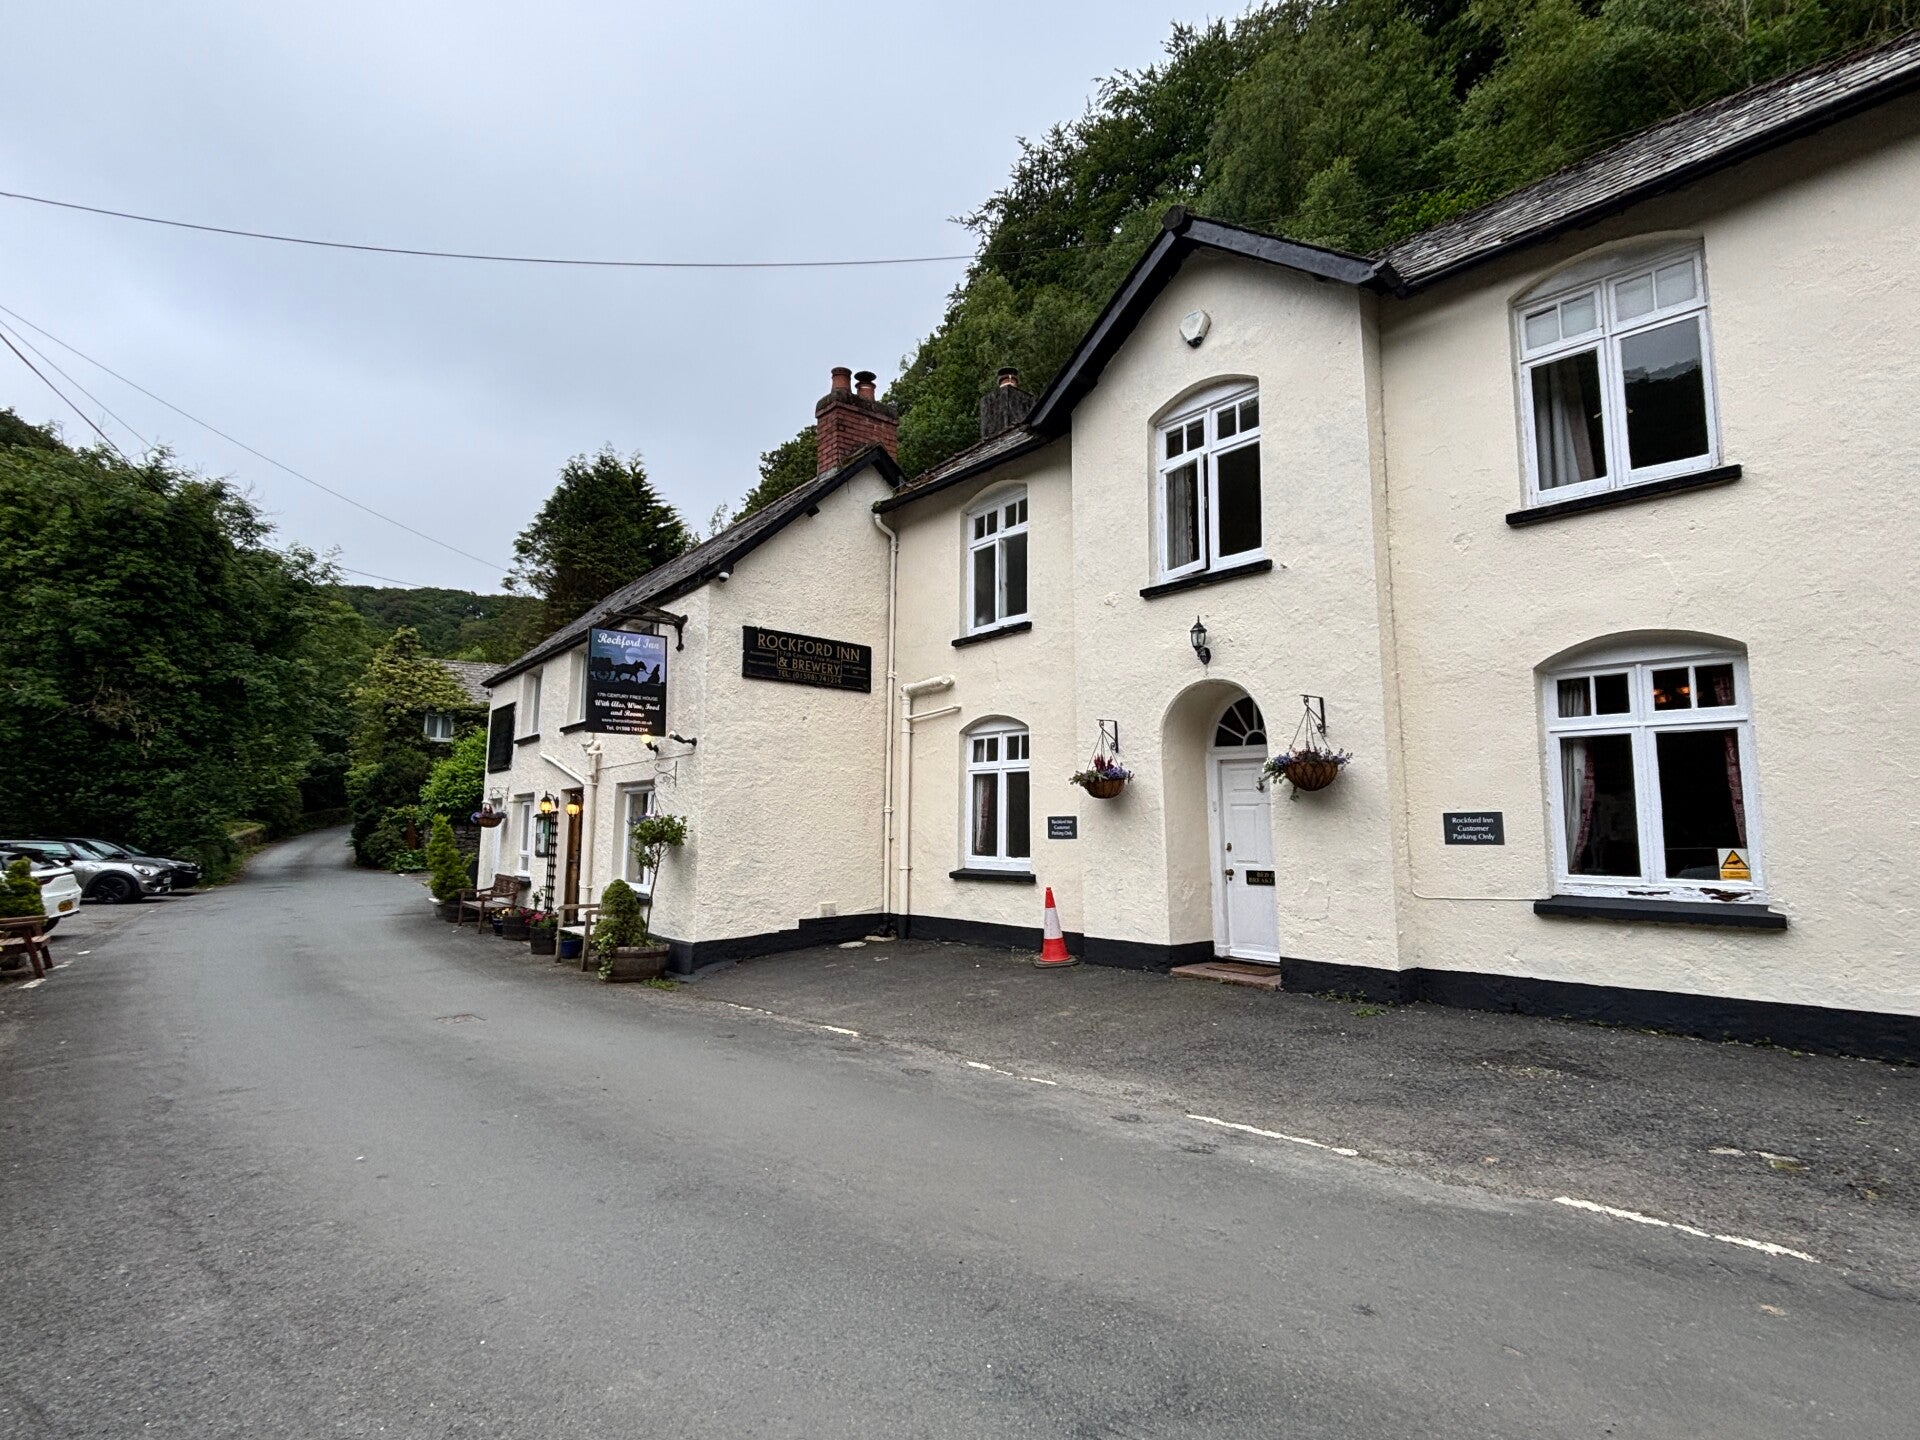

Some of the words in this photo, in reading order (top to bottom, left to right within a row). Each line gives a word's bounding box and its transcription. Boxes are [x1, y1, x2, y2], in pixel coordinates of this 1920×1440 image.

[598, 632, 640, 648] Rockford
[642, 639, 660, 650] Inn
[757, 633, 833, 657] ROCKFORD
[837, 646, 860, 661] INN
[778, 656, 788, 667] &
[792, 658, 841, 675] BREWERY
[1478, 833, 1496, 841] Only
